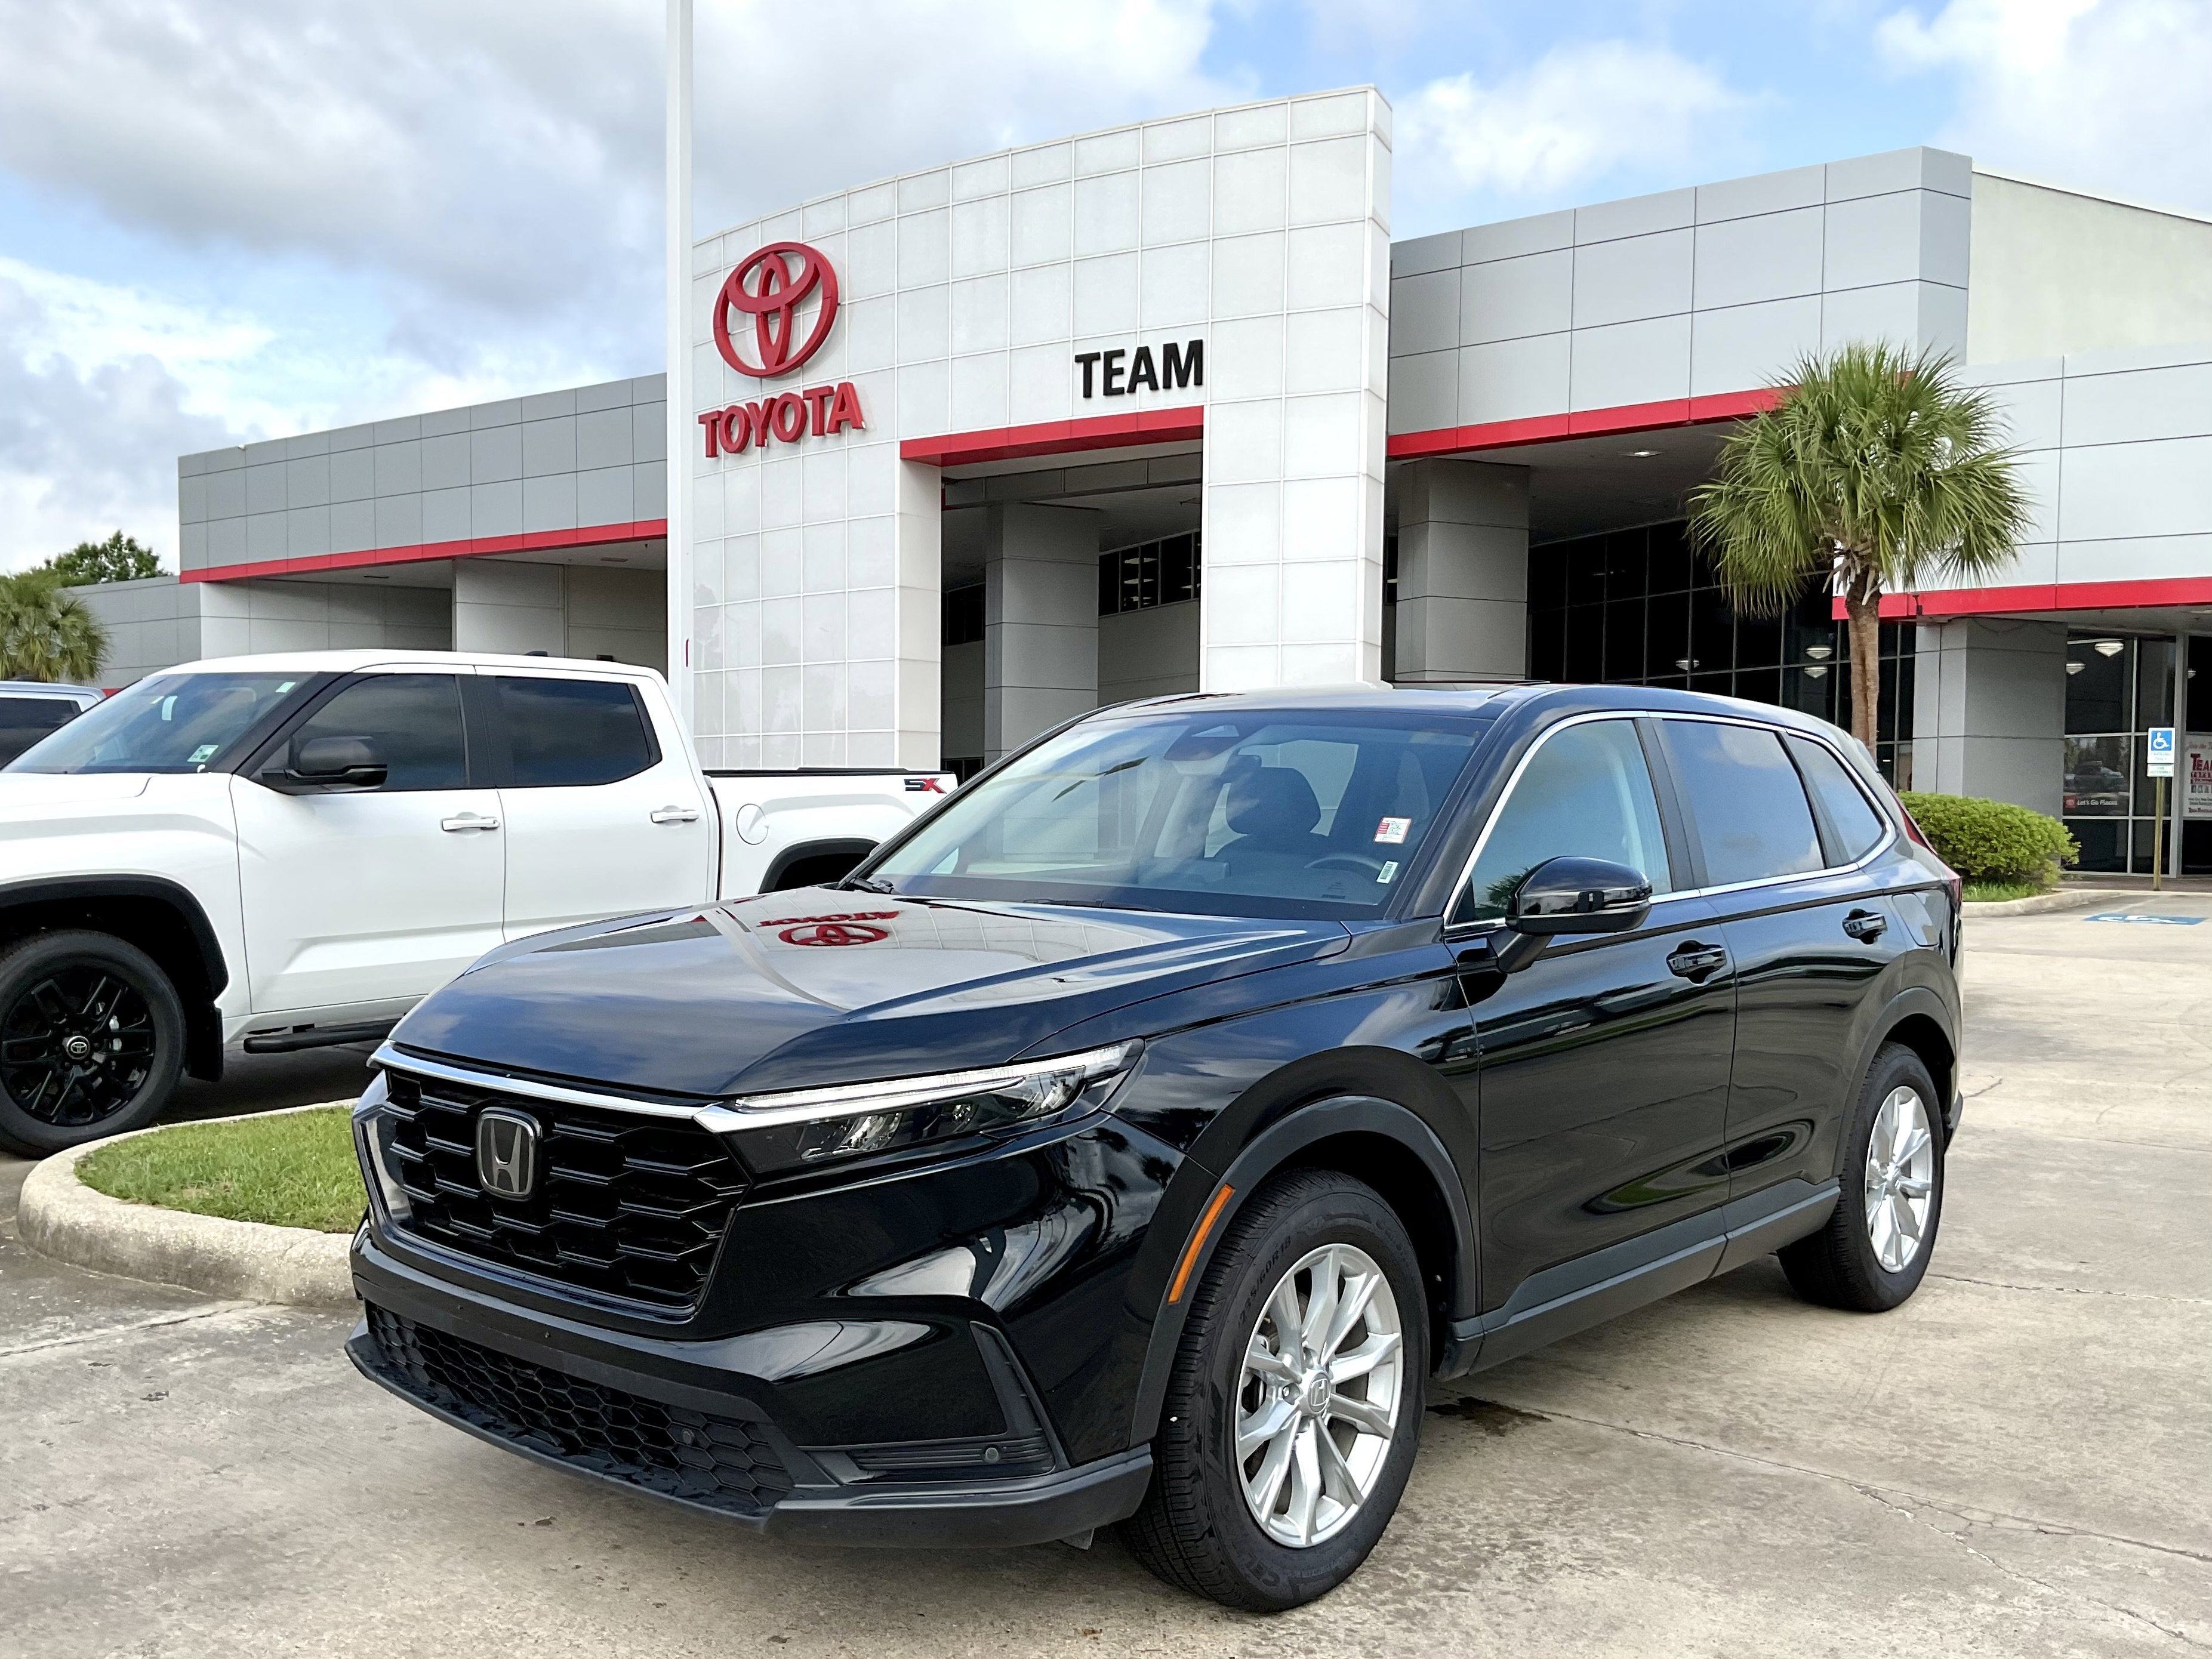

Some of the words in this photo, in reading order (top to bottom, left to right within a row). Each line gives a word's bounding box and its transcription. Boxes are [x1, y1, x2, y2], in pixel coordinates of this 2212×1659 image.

[1075, 339, 1203, 398] TEAM
[698, 382, 865, 458] TOYOTA
[2190, 753, 2212, 771] TEA
